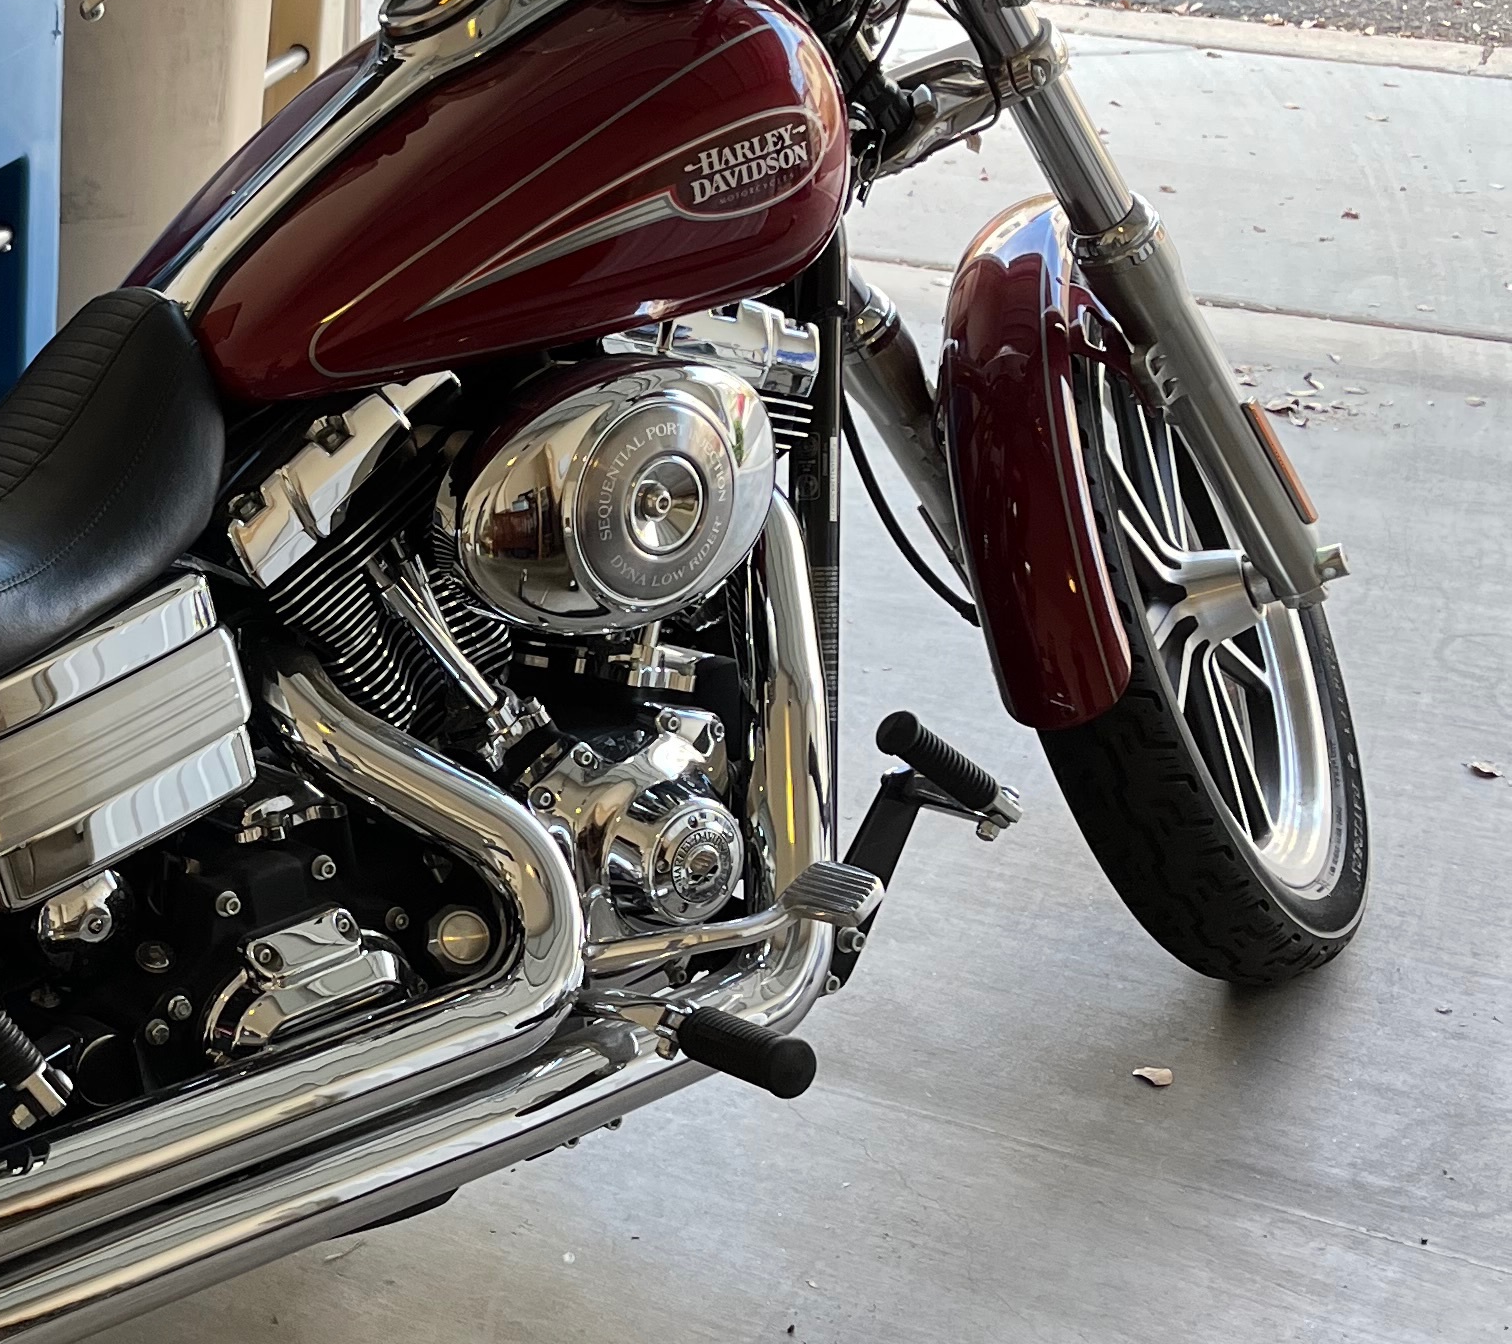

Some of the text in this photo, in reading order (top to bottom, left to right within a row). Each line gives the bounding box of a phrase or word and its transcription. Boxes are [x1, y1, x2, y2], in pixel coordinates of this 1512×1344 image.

[690, 141, 807, 205] DAVIDSON
[597, 436, 646, 542] SEQUENTIAL
[645, 422, 683, 441] PORT
[610, 519, 724, 587] DYNA LOW RIDER
